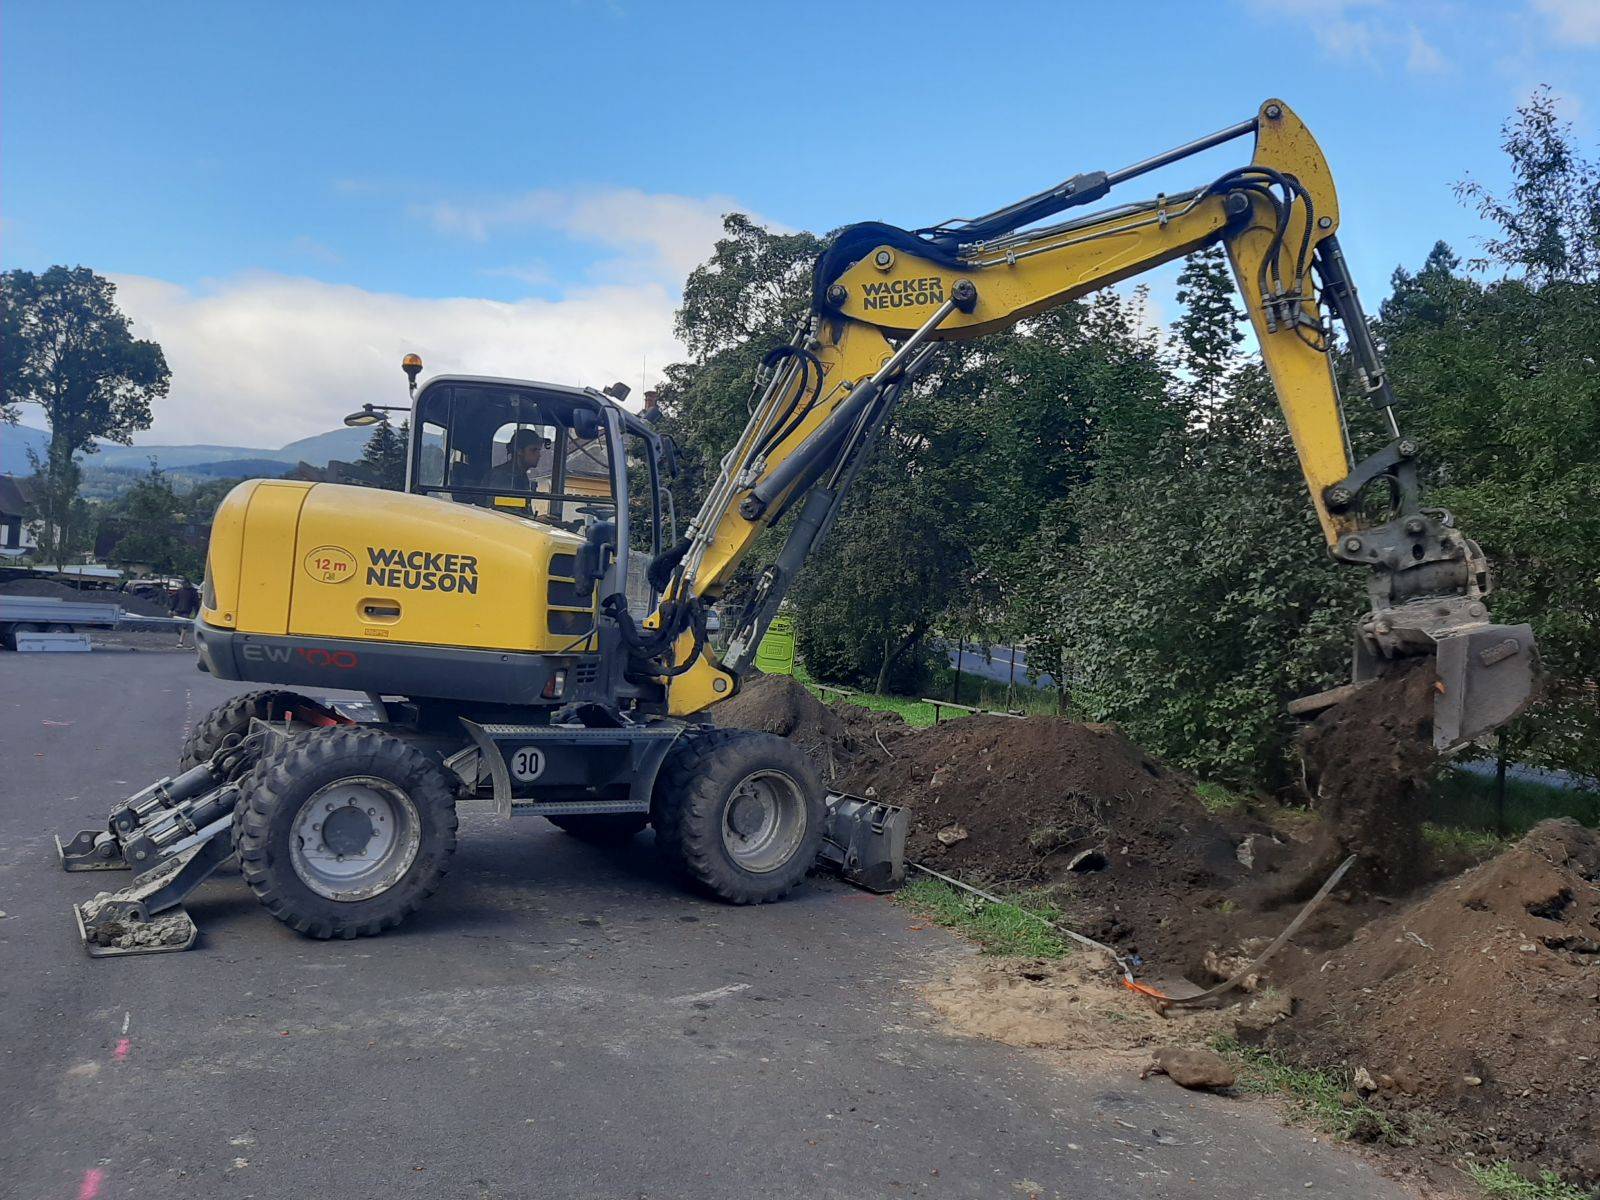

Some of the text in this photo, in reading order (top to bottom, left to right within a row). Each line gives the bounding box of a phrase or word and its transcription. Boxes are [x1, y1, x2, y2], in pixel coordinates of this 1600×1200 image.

[861, 277, 944, 296] WACKER
[863, 290, 944, 310] NEUSON
[315, 558, 348, 572] 12 m
[366, 547, 478, 575] WACKER
[366, 566, 478, 595] NEUSON
[517, 753, 539, 774] 30
